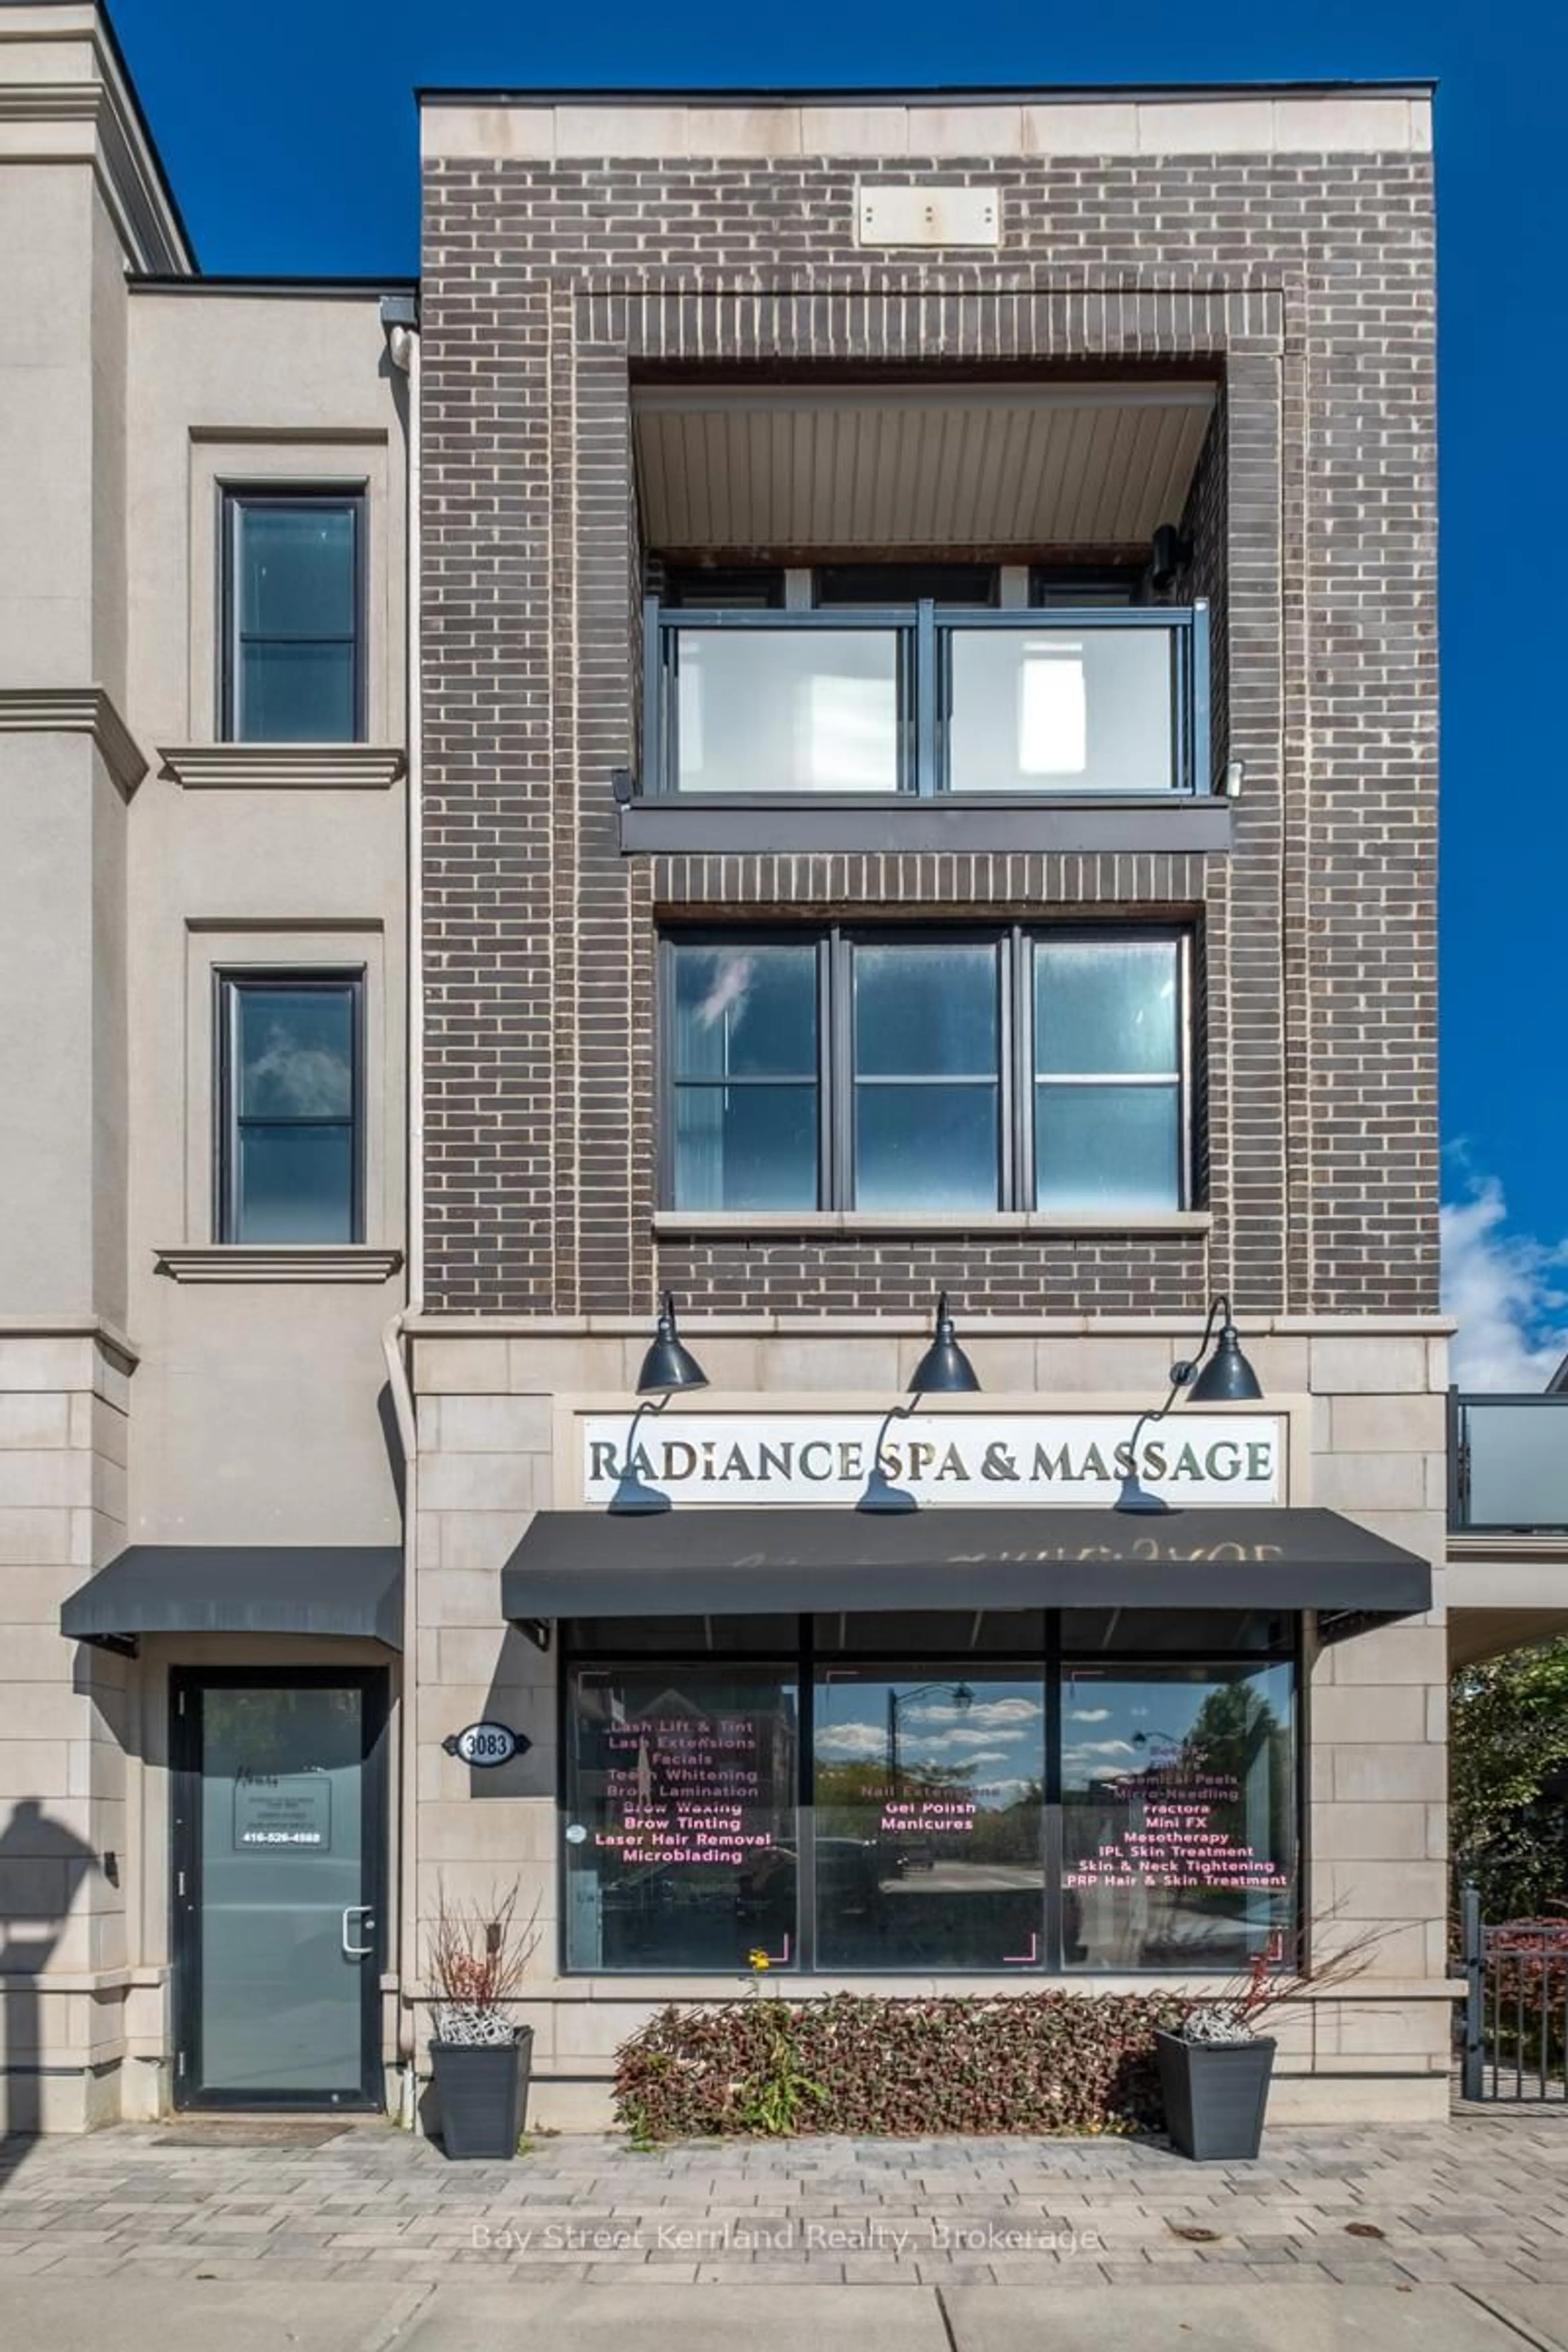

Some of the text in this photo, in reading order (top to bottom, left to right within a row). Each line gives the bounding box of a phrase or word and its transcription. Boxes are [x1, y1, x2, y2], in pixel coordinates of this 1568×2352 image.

[880, 1442, 970, 1481] SPA
[980, 1441, 1021, 1481] &
[1029, 1441, 1274, 1481] MASSAGE
[611, 1720, 753, 1732] Lash Lift & Tint
[466, 1734, 507, 1755] 3083
[657, 1737, 756, 1749] Extensions
[653, 1753, 713, 1765] Facials
[666, 1770, 758, 1784] Whitening
[1115, 1774, 1238, 1785] emical Peels
[660, 1786, 759, 1797] Lamination
[623, 1802, 742, 1815] Brow Waxing
[885, 1802, 976, 1814] Gel Polish
[1143, 1804, 1211, 1814] Fractora
[624, 1817, 742, 1832] Brow Tinting
[881, 1817, 973, 1830] Manicures
[1146, 1817, 1207, 1828] Mini FX
[595, 1833, 771, 1846] Laser Hair Removal
[1124, 1831, 1229, 1844] Mesotherapy
[623, 1849, 743, 1864] Microblading
[1099, 1846, 1254, 1858] IPL Skin Treatment
[1079, 1860, 1276, 1873] Skin & Neck Tightening
[1067, 1875, 1287, 1886] PRP Hair & Skin Treatment
